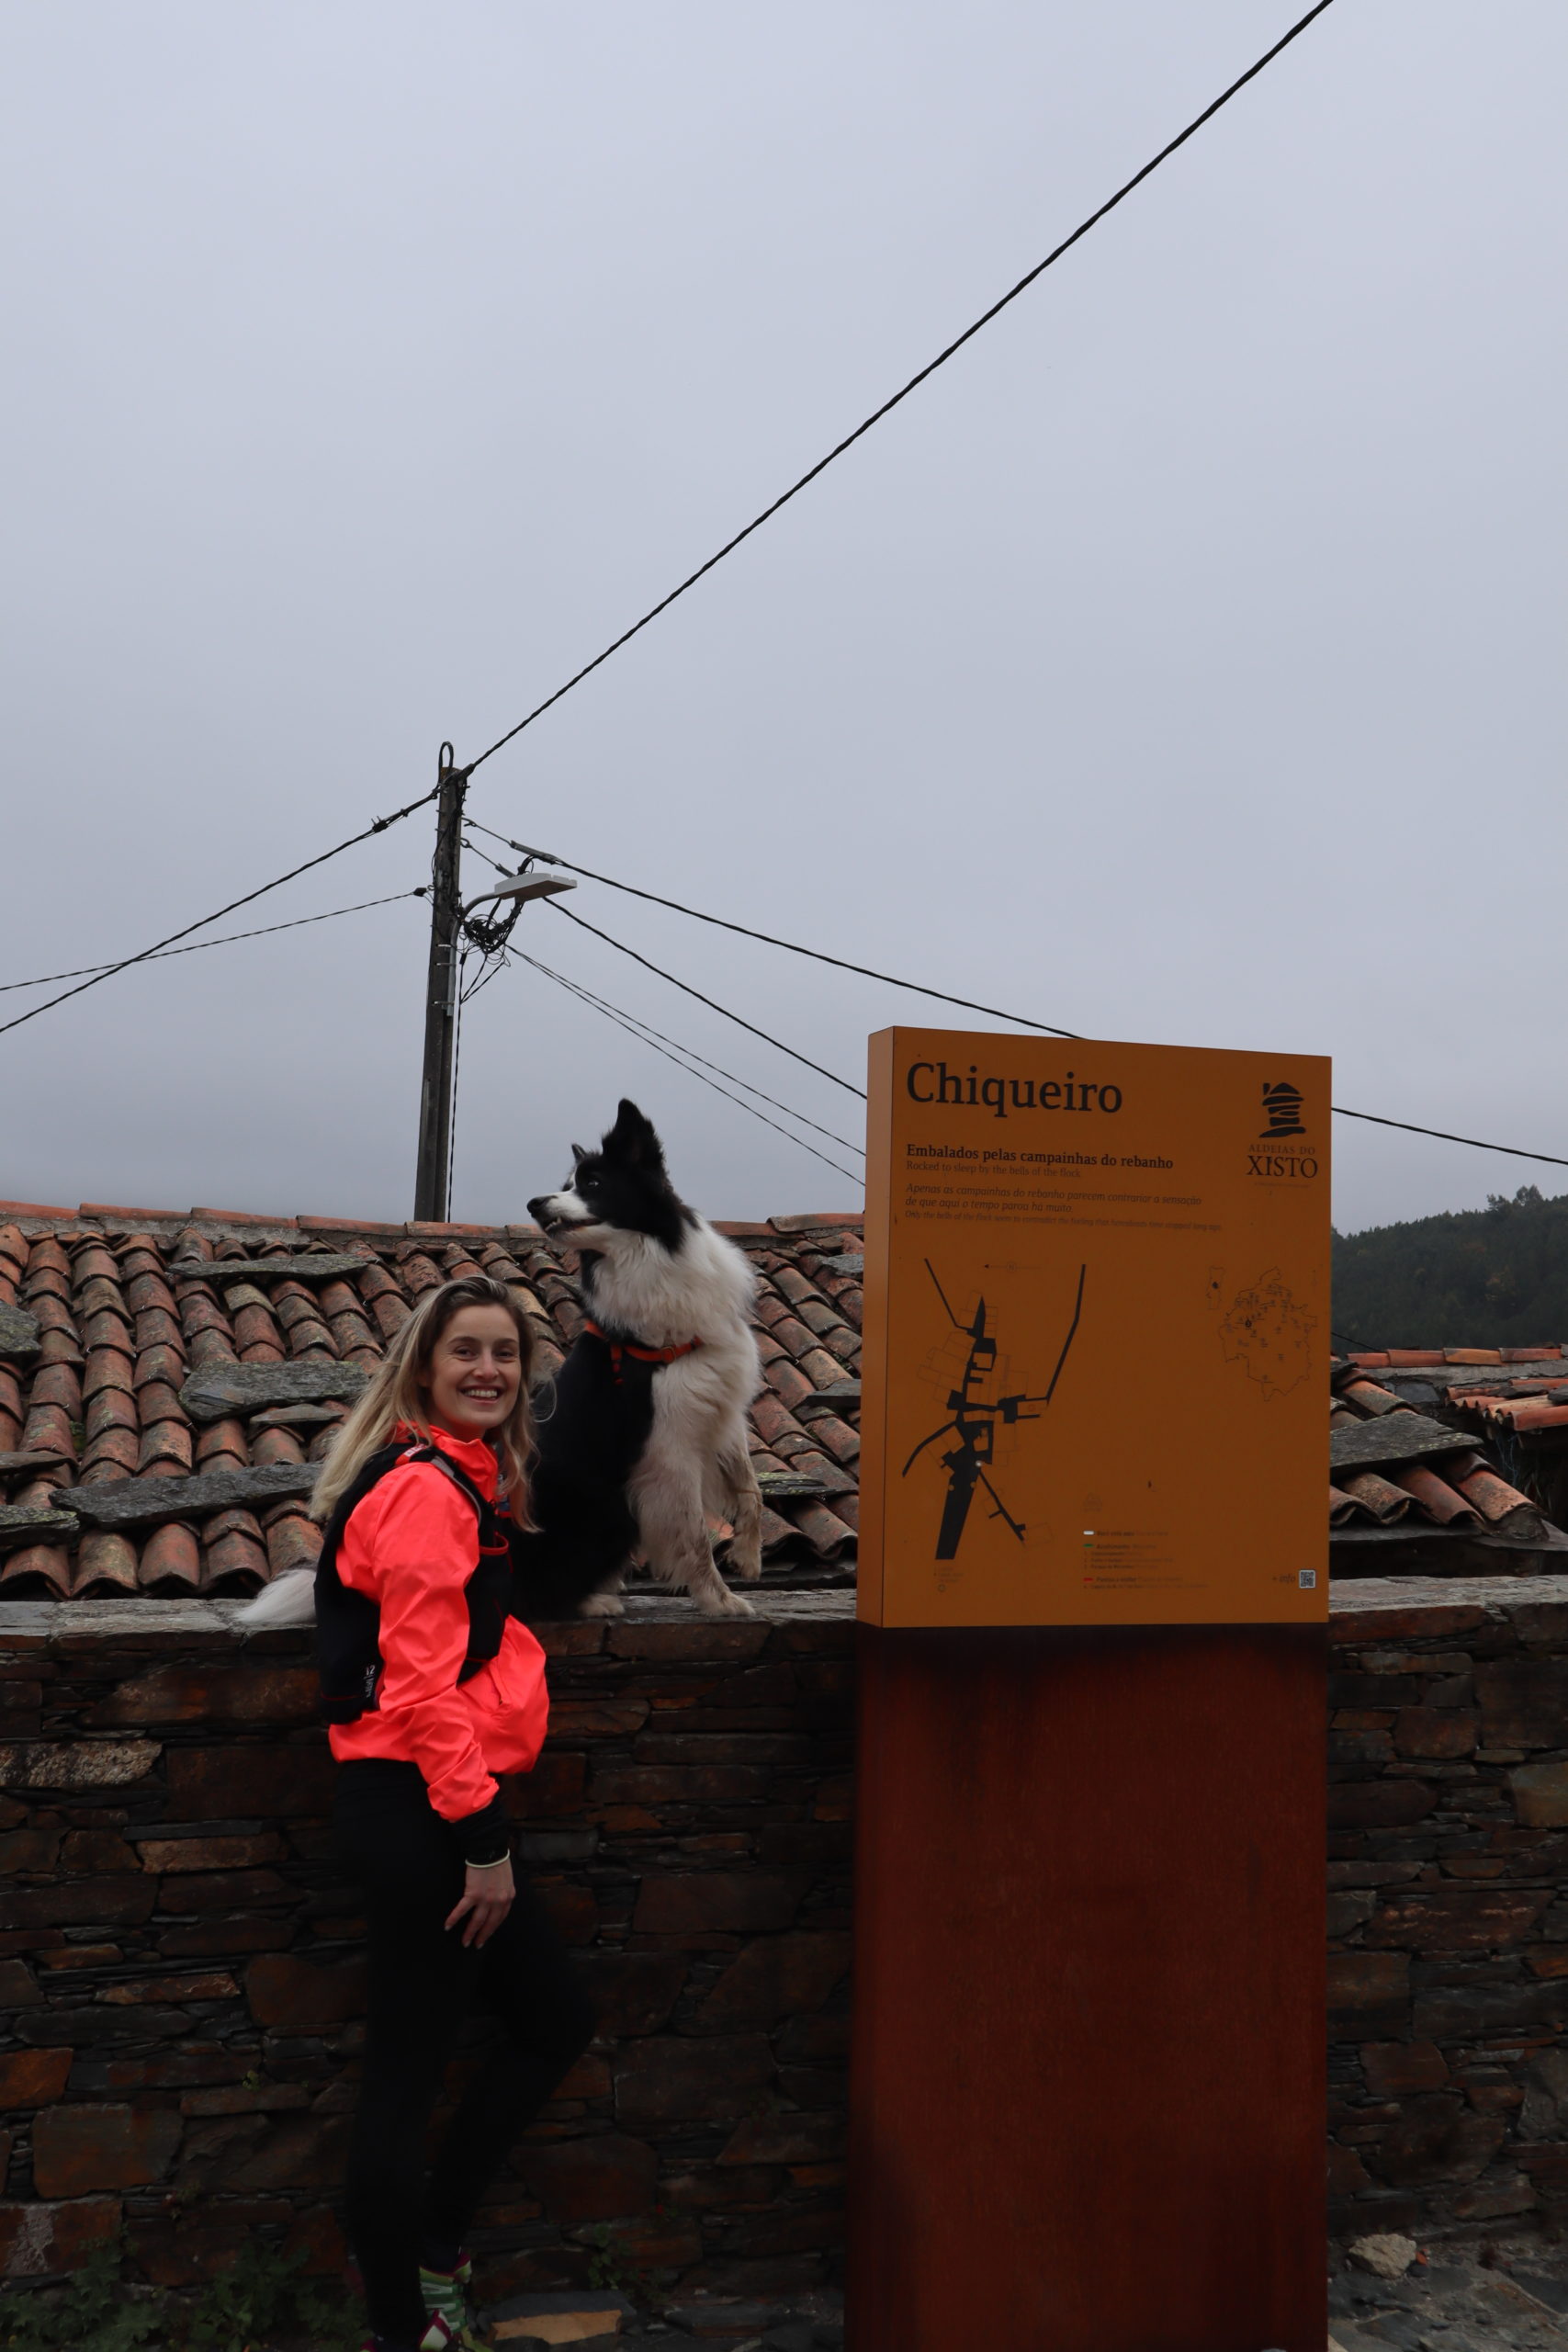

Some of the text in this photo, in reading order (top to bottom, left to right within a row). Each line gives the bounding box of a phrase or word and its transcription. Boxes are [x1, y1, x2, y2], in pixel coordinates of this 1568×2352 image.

[906, 1062, 1122, 1117] Chiqueiro
[907, 1143, 1174, 1170] Embalados pelas campainhas do rebanho
[1248, 1143, 1315, 1156] ALDEIAS DO
[907, 1160, 1081, 1179] Rocked to sleep by the bells of the flock
[1246, 1154, 1318, 1178] XISTO
[905, 1182, 942, 1196] Apenas
[943, 1185, 953, 1194] as
[956, 1185, 1011, 1198] campainhas
[1013, 1187, 1025, 1197] do
[1028, 1188, 1066, 1200] rebanho
[1066, 1193, 1106, 1203] parecem
[1107, 1193, 1152, 1204] contrariar
[1162, 1195, 1202, 1206] sensação
[905, 1197, 917, 1206] de
[919, 1198, 937, 1208] que
[939, 1198, 960, 1210] aqui
[971, 1199, 1000, 1211] tempo
[1001, 1202, 1029, 1213] parou
[1032, 1201, 1043, 1212] há
